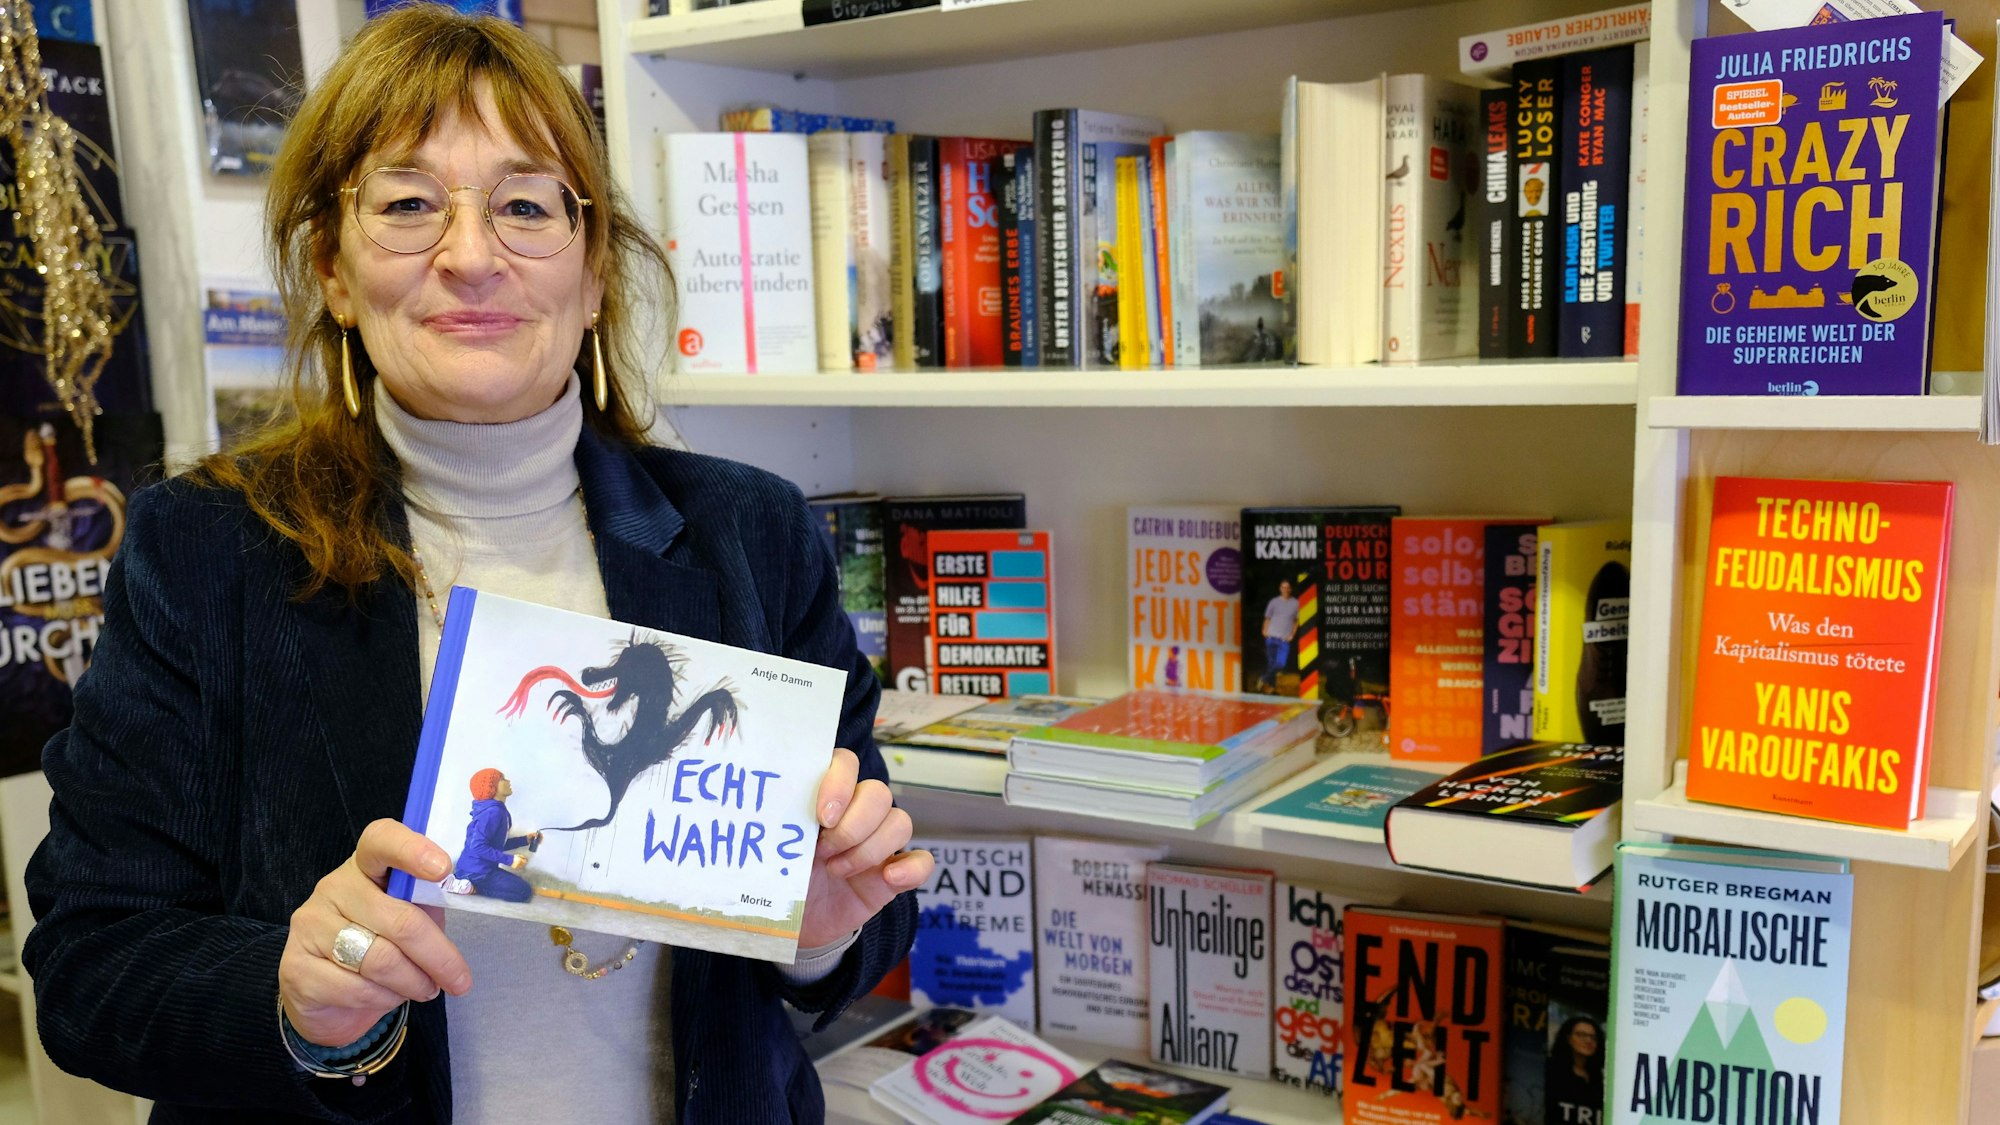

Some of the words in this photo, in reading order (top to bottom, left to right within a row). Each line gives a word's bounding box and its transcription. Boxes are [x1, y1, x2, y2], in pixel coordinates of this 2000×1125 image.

[1507, 25, 1560, 47] GLAUBE
[1514, 45, 1543, 57] NOCUN
[1546, 36, 1594, 50] KATHARINA
[1716, 51, 1774, 79] JULIA
[1781, 36, 1911, 72] FRIEDRICHS
[1579, 65, 1592, 125] CONGER
[1593, 88, 1606, 121] MAC
[1720, 101, 1774, 112] Bestseller-
[1726, 88, 1768, 100] SPIEGEL
[1517, 79, 1533, 158] LUCKY
[1536, 78, 1554, 156] LOSER
[1727, 110, 1766, 120] Autorin
[1579, 127, 1591, 167] KATE
[1592, 126, 1605, 166] RYAN
[1711, 114, 1911, 189] CRAZY
[704, 161, 779, 184] Masha
[1051, 119, 1067, 207] BESATZUNG
[698, 194, 784, 217] Gessen
[1566, 192, 1580, 224] UND
[915, 161, 929, 294] TODESWALZER
[1534, 221, 1544, 255] CRAIG
[1580, 180, 1598, 276] ZERSTÖRUNG
[1598, 204, 1615, 268] TWITTER
[1708, 182, 1904, 275] RICH
[1006, 228, 1020, 268] ERBE
[1053, 213, 1069, 293] DEUTSCHER
[1384, 204, 1405, 288] Nexus
[1521, 221, 1532, 279] BUETTNER
[1566, 225, 1579, 265] MUSK
[1521, 282, 1531, 309] RUSS
[1532, 257, 1543, 309] SUSANNE
[1565, 266, 1578, 303] ELON
[1580, 276, 1595, 303] DIE
[1597, 271, 1614, 303] VON
[1008, 275, 1022, 351] BRAUNES
[1874, 294, 1906, 305] berlin
[1055, 294, 1070, 348] UNTER
[1705, 326, 1732, 344] DIE
[1736, 325, 1806, 343] GEHEIME
[1812, 324, 1856, 342] WELT
[1862, 323, 1896, 342] DER
[1733, 346, 1863, 365] SUPERREICHEN
[1768, 381, 1802, 393] berlin
[891, 508, 936, 521] DANA
[940, 506, 1015, 519] MATTIOLI
[1134, 517, 1175, 537] CATRIN
[1178, 520, 1241, 541] BOLDEBUC
[1756, 497, 1890, 544] TECHNO-
[1254, 525, 1318, 540] HASNAIN
[1325, 525, 1389, 539] DEUTSCH
[935, 555, 986, 576] ERSTE
[1255, 540, 1318, 560] KAZIM
[1325, 541, 1389, 559] LAND
[1133, 548, 1201, 588] JEDES
[1325, 561, 1389, 581] TOUR
[1715, 548, 1924, 603] FEUDALISMUS
[937, 586, 982, 606] HILFE
[1325, 605, 1359, 614] UNSER
[1361, 605, 1389, 614] LAND
[938, 613, 971, 636] FÜR
[1768, 611, 1811, 635] Was
[1816, 617, 1854, 638] den
[939, 643, 1047, 666] DEMOKRATIE-
[1538, 628, 1548, 688] Generation
[1714, 635, 1839, 667] Kapitalismus
[1846, 653, 1906, 674] tötete
[751, 667, 778, 683] Antje
[780, 673, 813, 688] Damm
[940, 675, 1002, 695] RETTER
[1755, 682, 1851, 735] YANIS
[1701, 727, 1901, 795] VAROUFAKIS
[672, 759, 781, 812] ECHT
[1438, 780, 1562, 799] HACKERN
[1488, 776, 1541, 788] VON
[1438, 790, 1543, 807] LERNEN
[1072, 858, 1130, 881] ROBERT
[740, 893, 773, 907] Moritz
[1203, 879, 1264, 896] SCHÜLLER
[1638, 873, 1719, 895] RUTGER
[1726, 884, 1831, 905] BREGMAN
[951, 900, 985, 912] DER
[1051, 909, 1077, 929] DIE
[1289, 885, 1336, 931] Ich
[1045, 929, 1084, 950] WELT
[1090, 936, 1123, 954] VON
[1150, 885, 1265, 979] Unheilige
[1636, 897, 1830, 968] MORALISCHE
[1065, 953, 1133, 976] MORGEN
[1355, 934, 1489, 1026] END
[1290, 997, 1320, 1016] und
[1160, 1002, 1239, 1072] Allianz
[1276, 1006, 1343, 1054] geg
[1352, 1008, 1490, 1102] ZEIT
[1631, 1053, 1822, 1125] AMBITION
